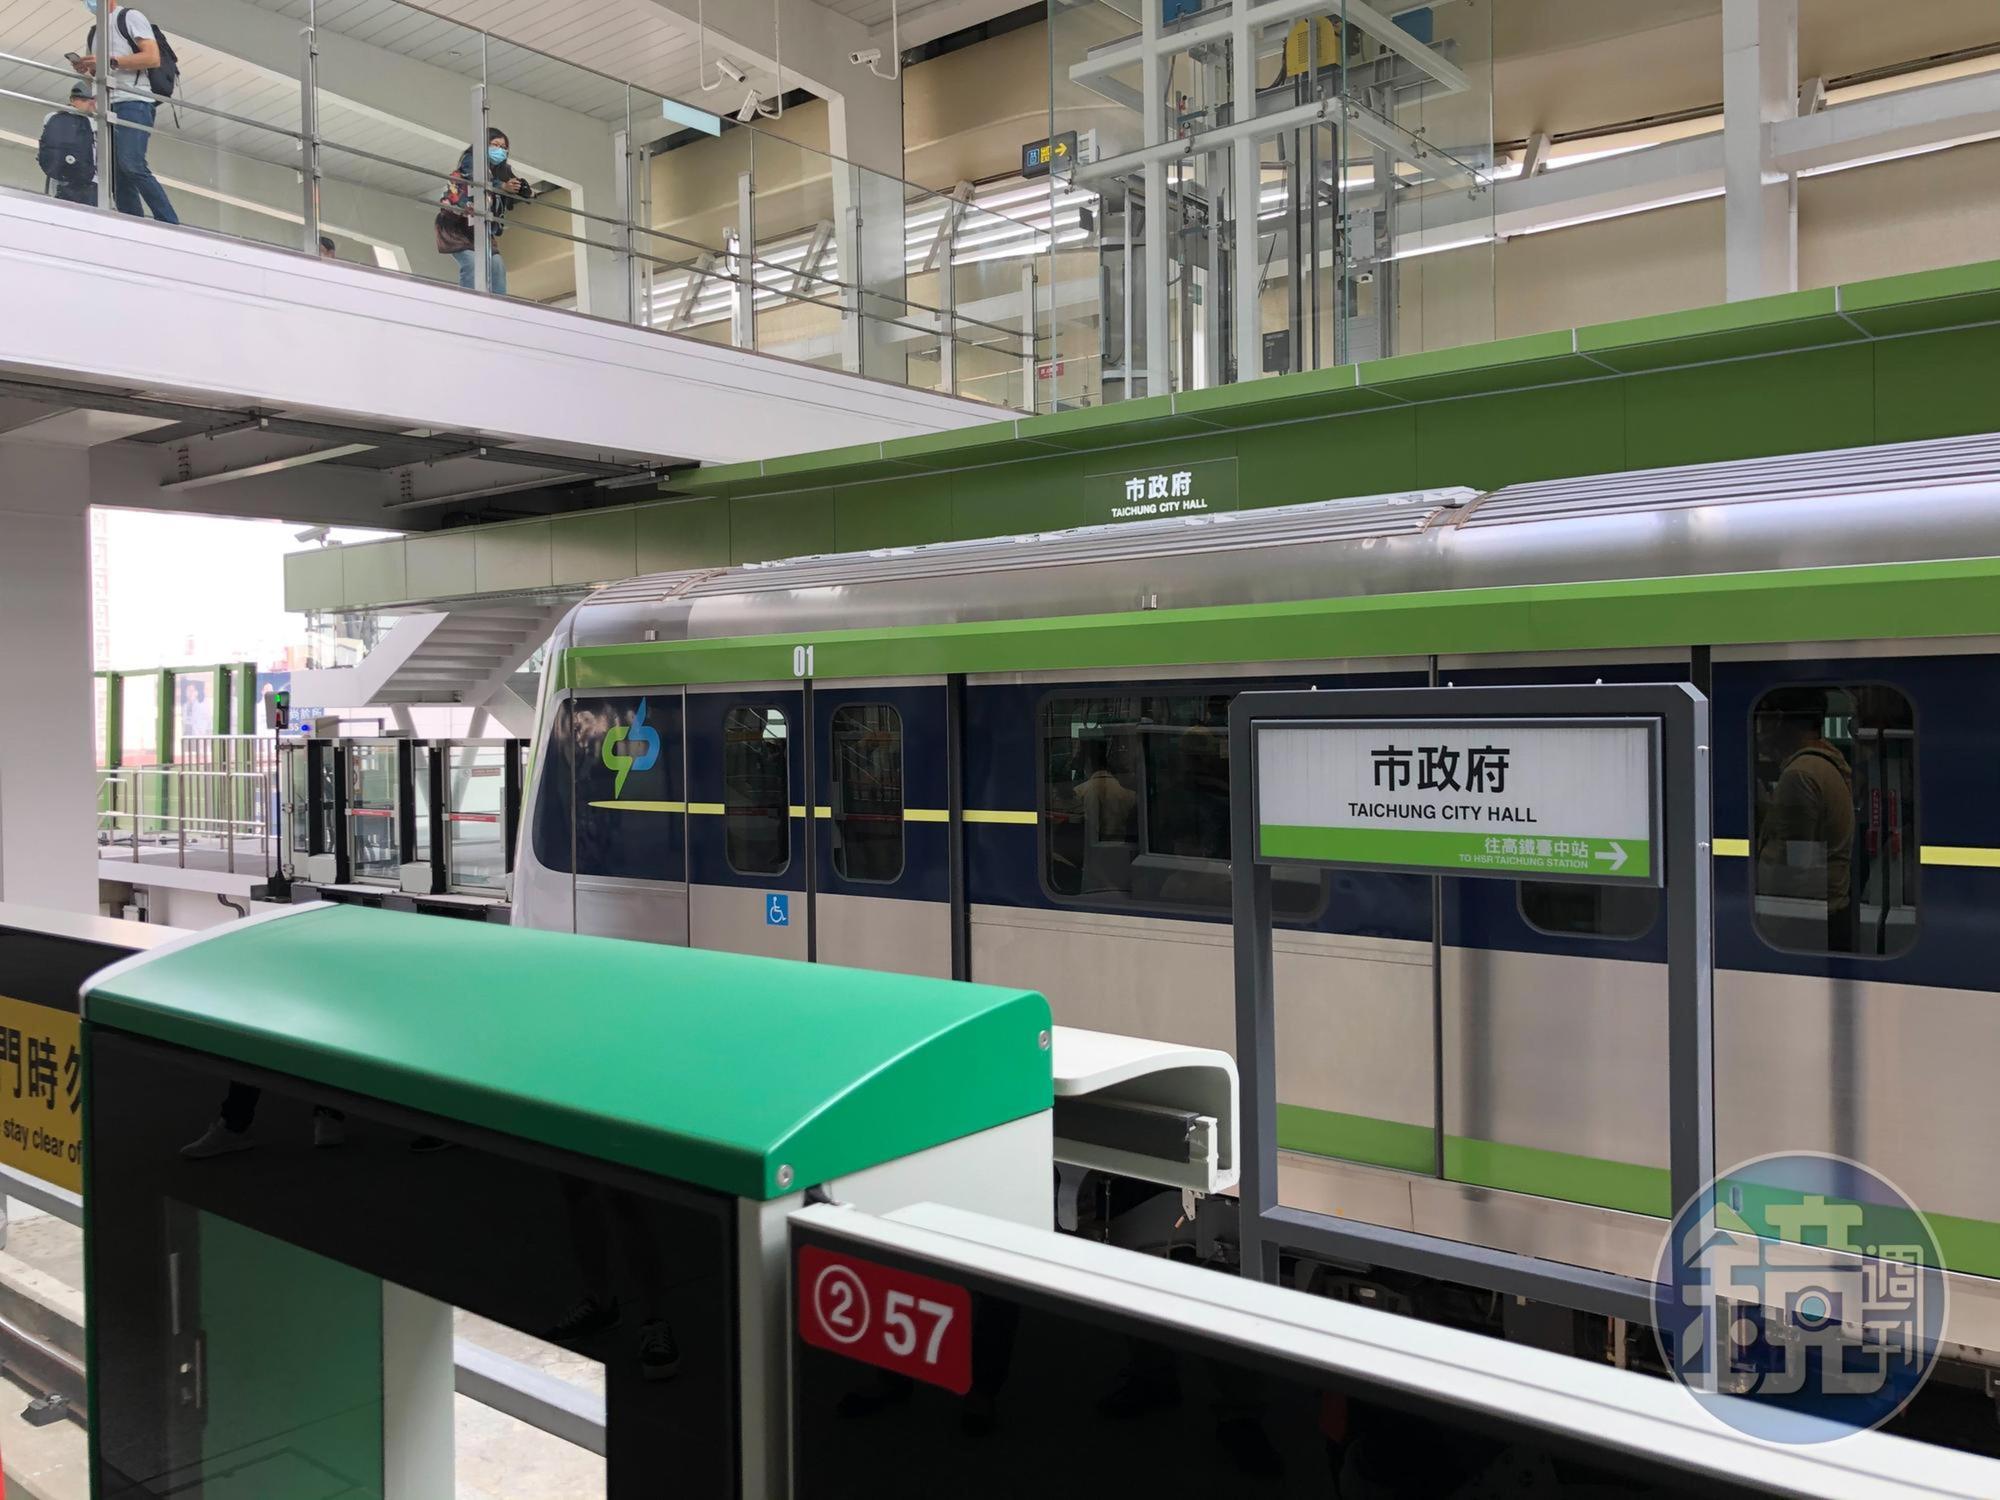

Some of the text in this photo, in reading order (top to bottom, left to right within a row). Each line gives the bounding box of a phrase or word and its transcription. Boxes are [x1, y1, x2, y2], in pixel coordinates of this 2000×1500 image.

[1125, 471, 1192, 502] 市政府
[1111, 498, 1208, 518] TAICHUNG CITY HALL
[793, 645, 814, 677] 01
[1371, 745, 1511, 794] 市政府
[1348, 802, 1538, 823] TAICHUNG CITY HALL
[1459, 853, 1589, 869] TO HSR TAICHUNG STATION
[1485, 836, 1590, 859] 往高鐵臺中站
[3, 1118, 29, 1150] stay
[32, 1127, 65, 1158] clear
[884, 1289, 954, 1365] 57
